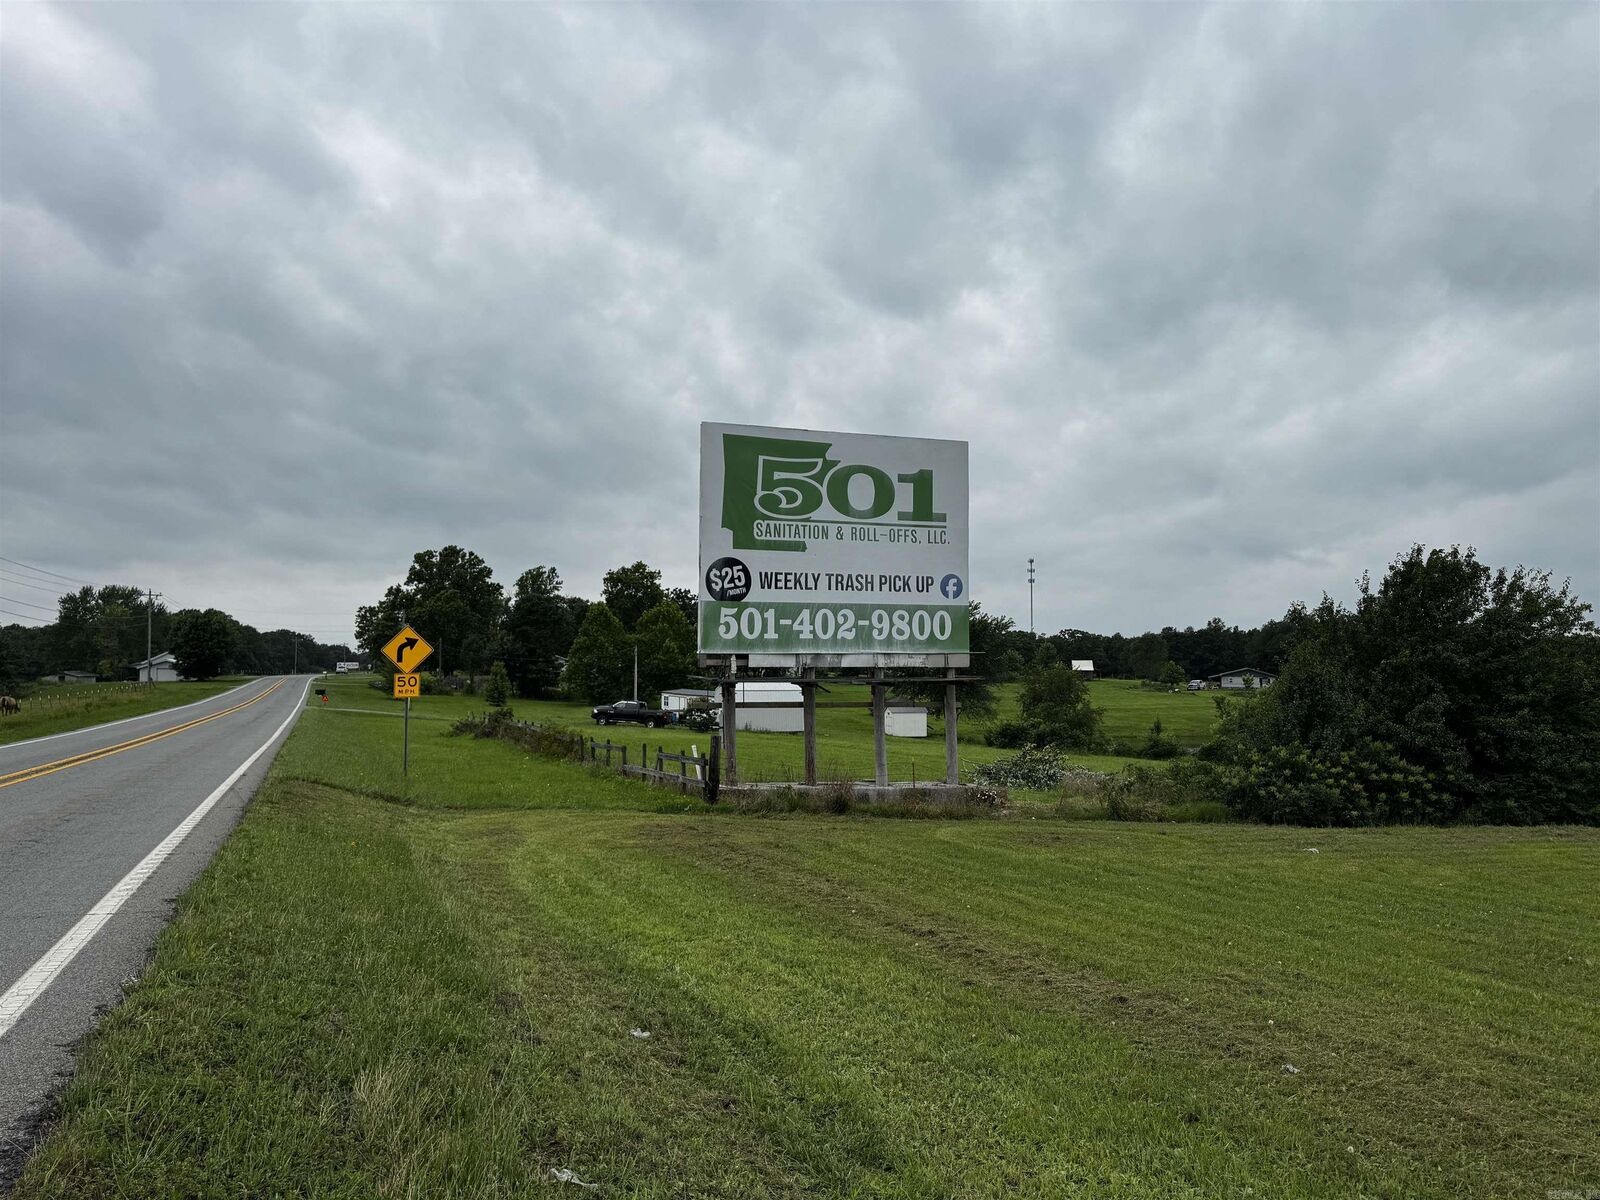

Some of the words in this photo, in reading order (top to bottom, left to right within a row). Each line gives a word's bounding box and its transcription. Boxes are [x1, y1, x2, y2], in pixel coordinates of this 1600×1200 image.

[754, 455, 947, 522] 501
[755, 522, 829, 541] SANITATION
[835, 526, 844, 541] &
[927, 530, 951, 545] LLC.
[709, 565, 746, 592] $25
[759, 570, 822, 591] WEEKLY
[825, 573, 874, 592] TRASH
[879, 574, 914, 593] PICK
[916, 575, 935, 593] UP
[718, 606, 952, 641] 501-402-9800
[397, 676, 417, 687] 50
